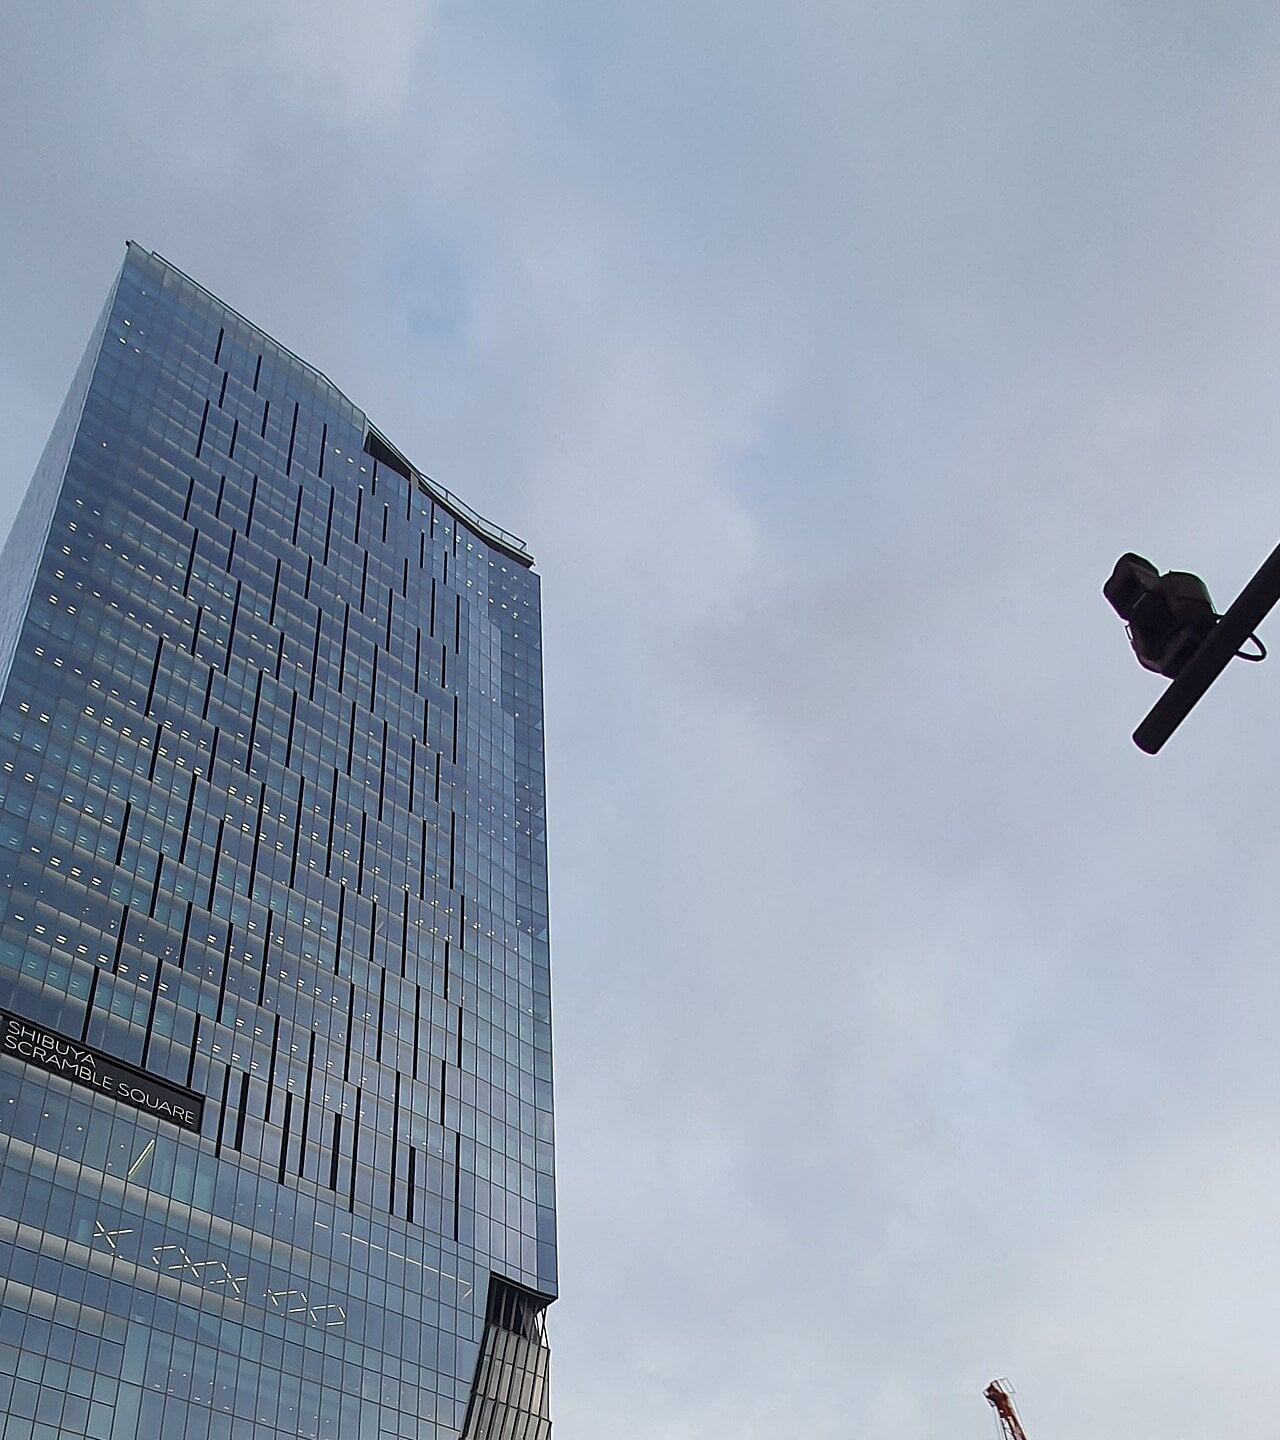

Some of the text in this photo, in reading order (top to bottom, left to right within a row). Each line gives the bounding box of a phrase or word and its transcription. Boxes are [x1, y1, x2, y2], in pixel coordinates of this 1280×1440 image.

[6, 1019, 96, 1067] SHIBUYA
[4, 1035, 195, 1125] SCRAMBLE SQUARE
